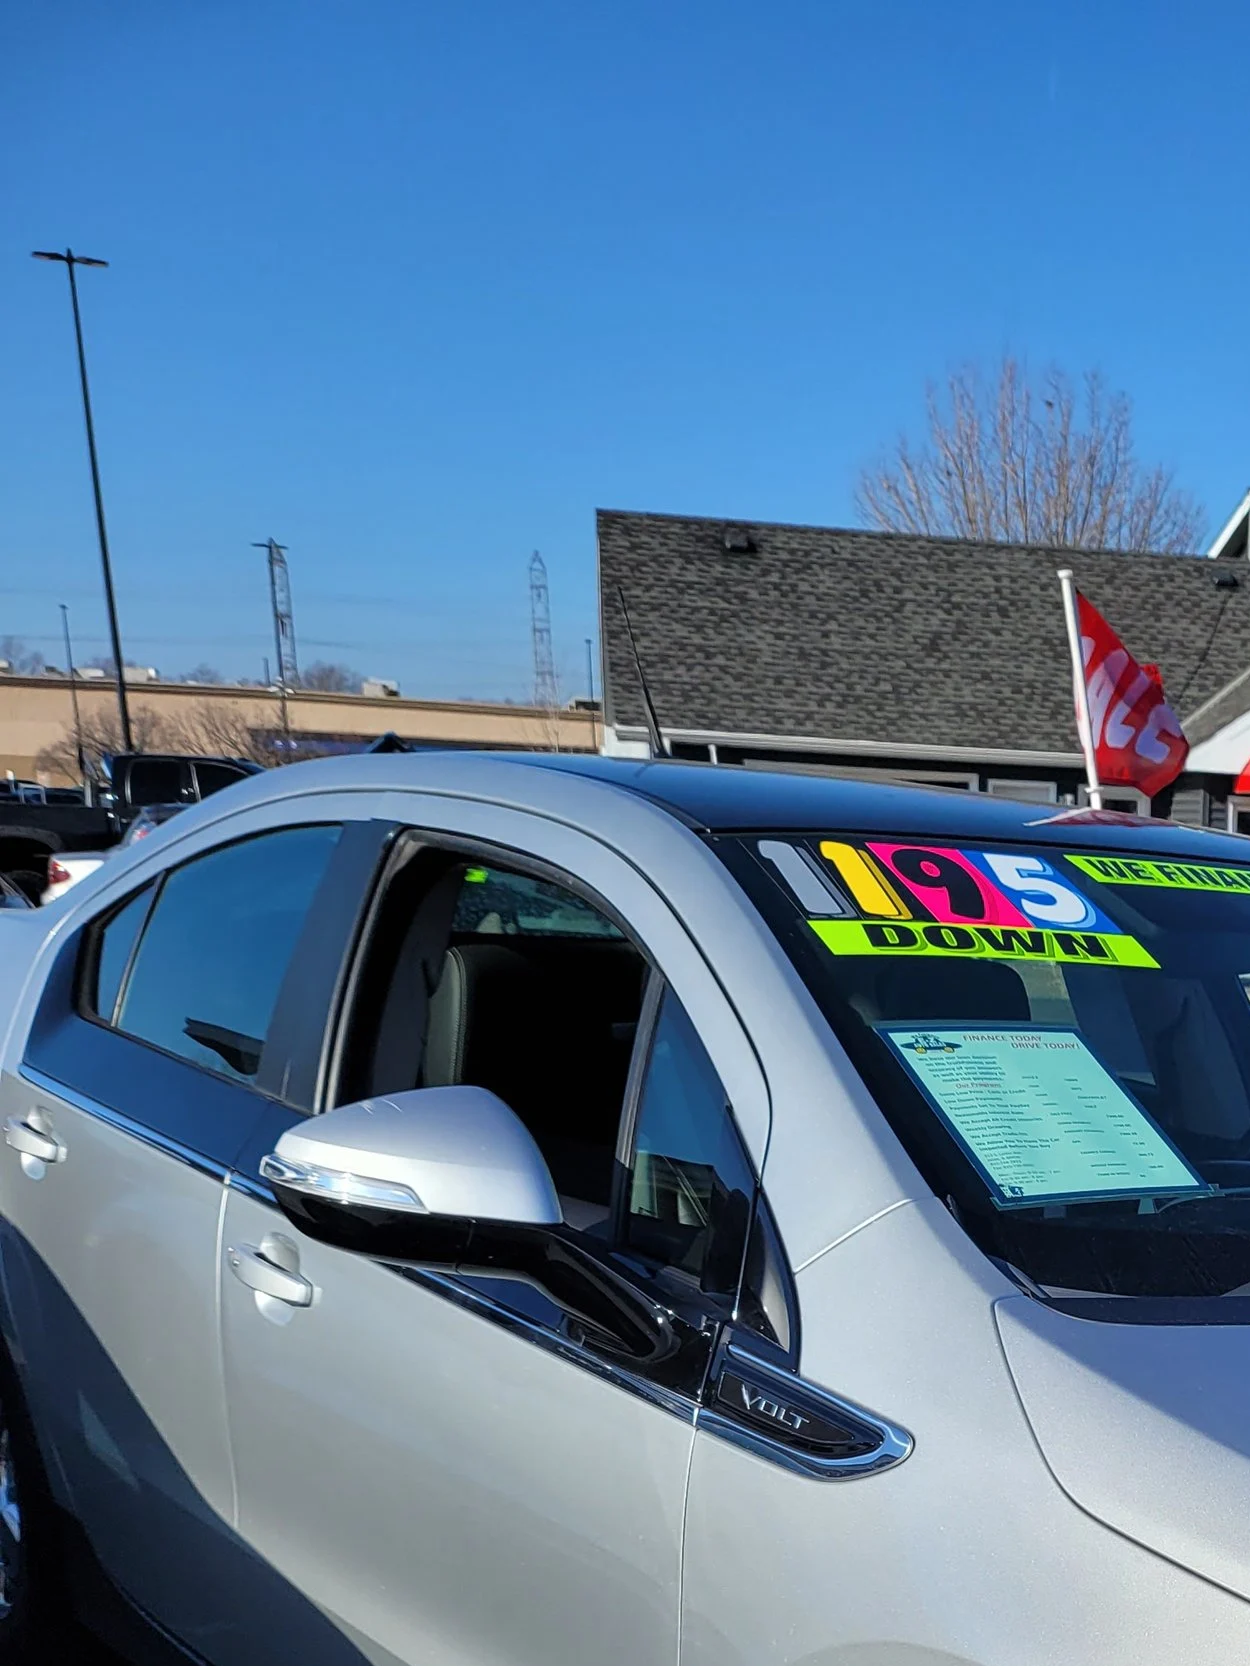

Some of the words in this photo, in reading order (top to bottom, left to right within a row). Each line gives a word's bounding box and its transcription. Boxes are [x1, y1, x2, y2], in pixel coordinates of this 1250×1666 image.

[757, 840, 1095, 927] 1195
[1082, 858, 1153, 880] WE
[861, 923, 1116, 961] DOWN
[962, 1034, 1007, 1042] FINANCE
[741, 1384, 810, 1430] VOLT
